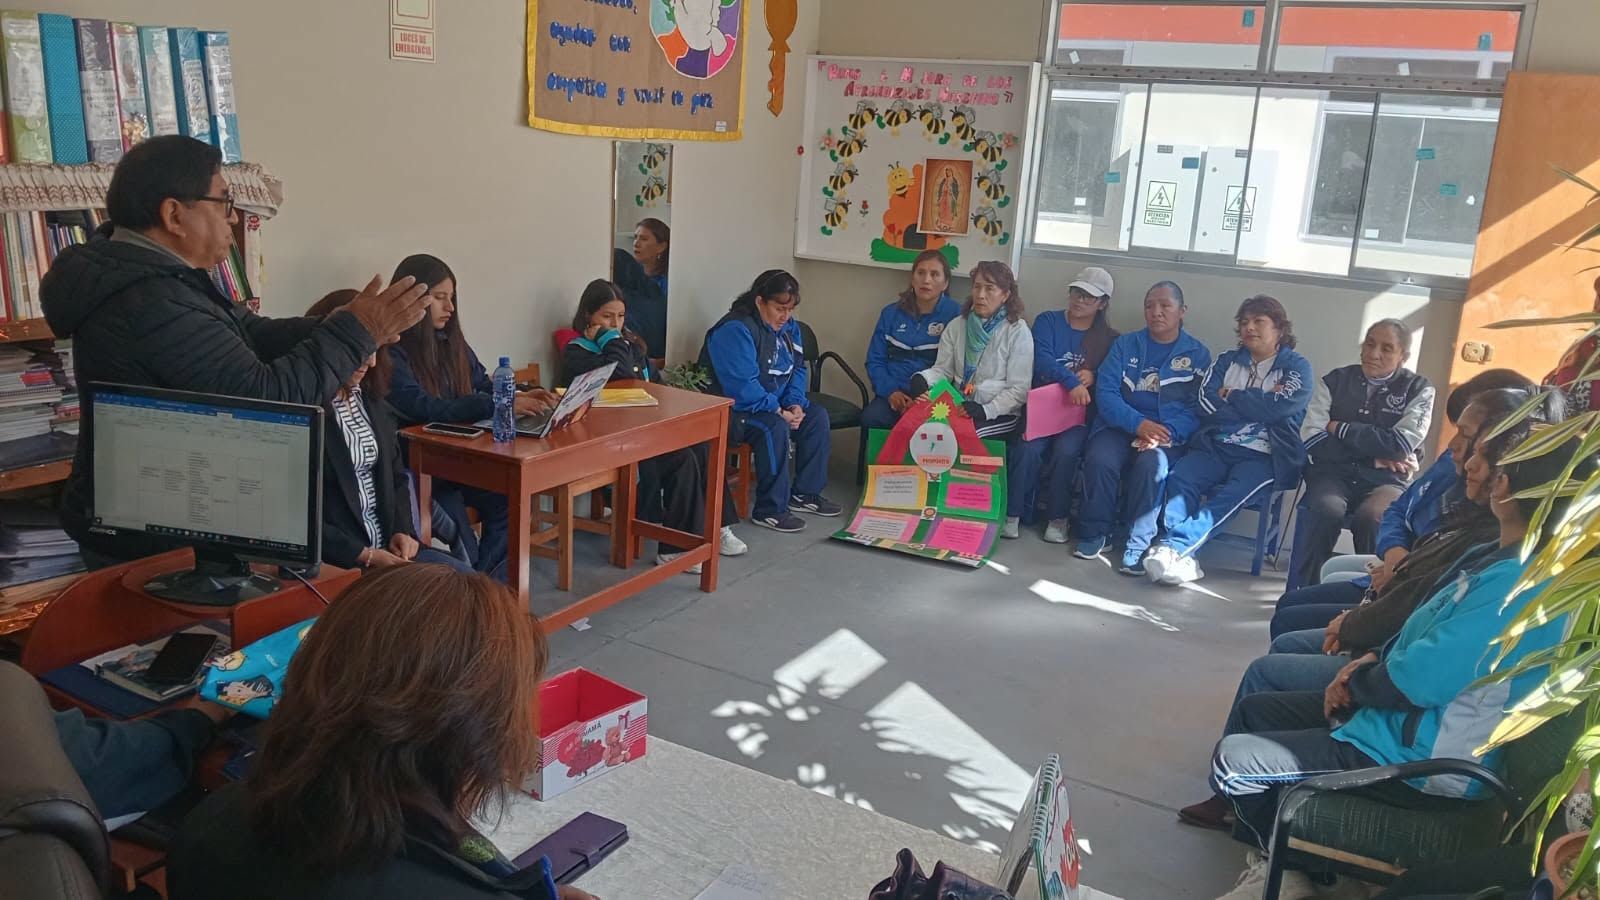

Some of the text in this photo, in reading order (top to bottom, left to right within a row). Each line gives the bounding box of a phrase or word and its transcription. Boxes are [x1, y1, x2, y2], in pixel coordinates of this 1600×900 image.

[400, 32, 418, 43] LUCES
[395, 43, 432, 56] EMERGENCIA
[617, 87, 627, 106] y
[691, 92, 714, 115] paz
